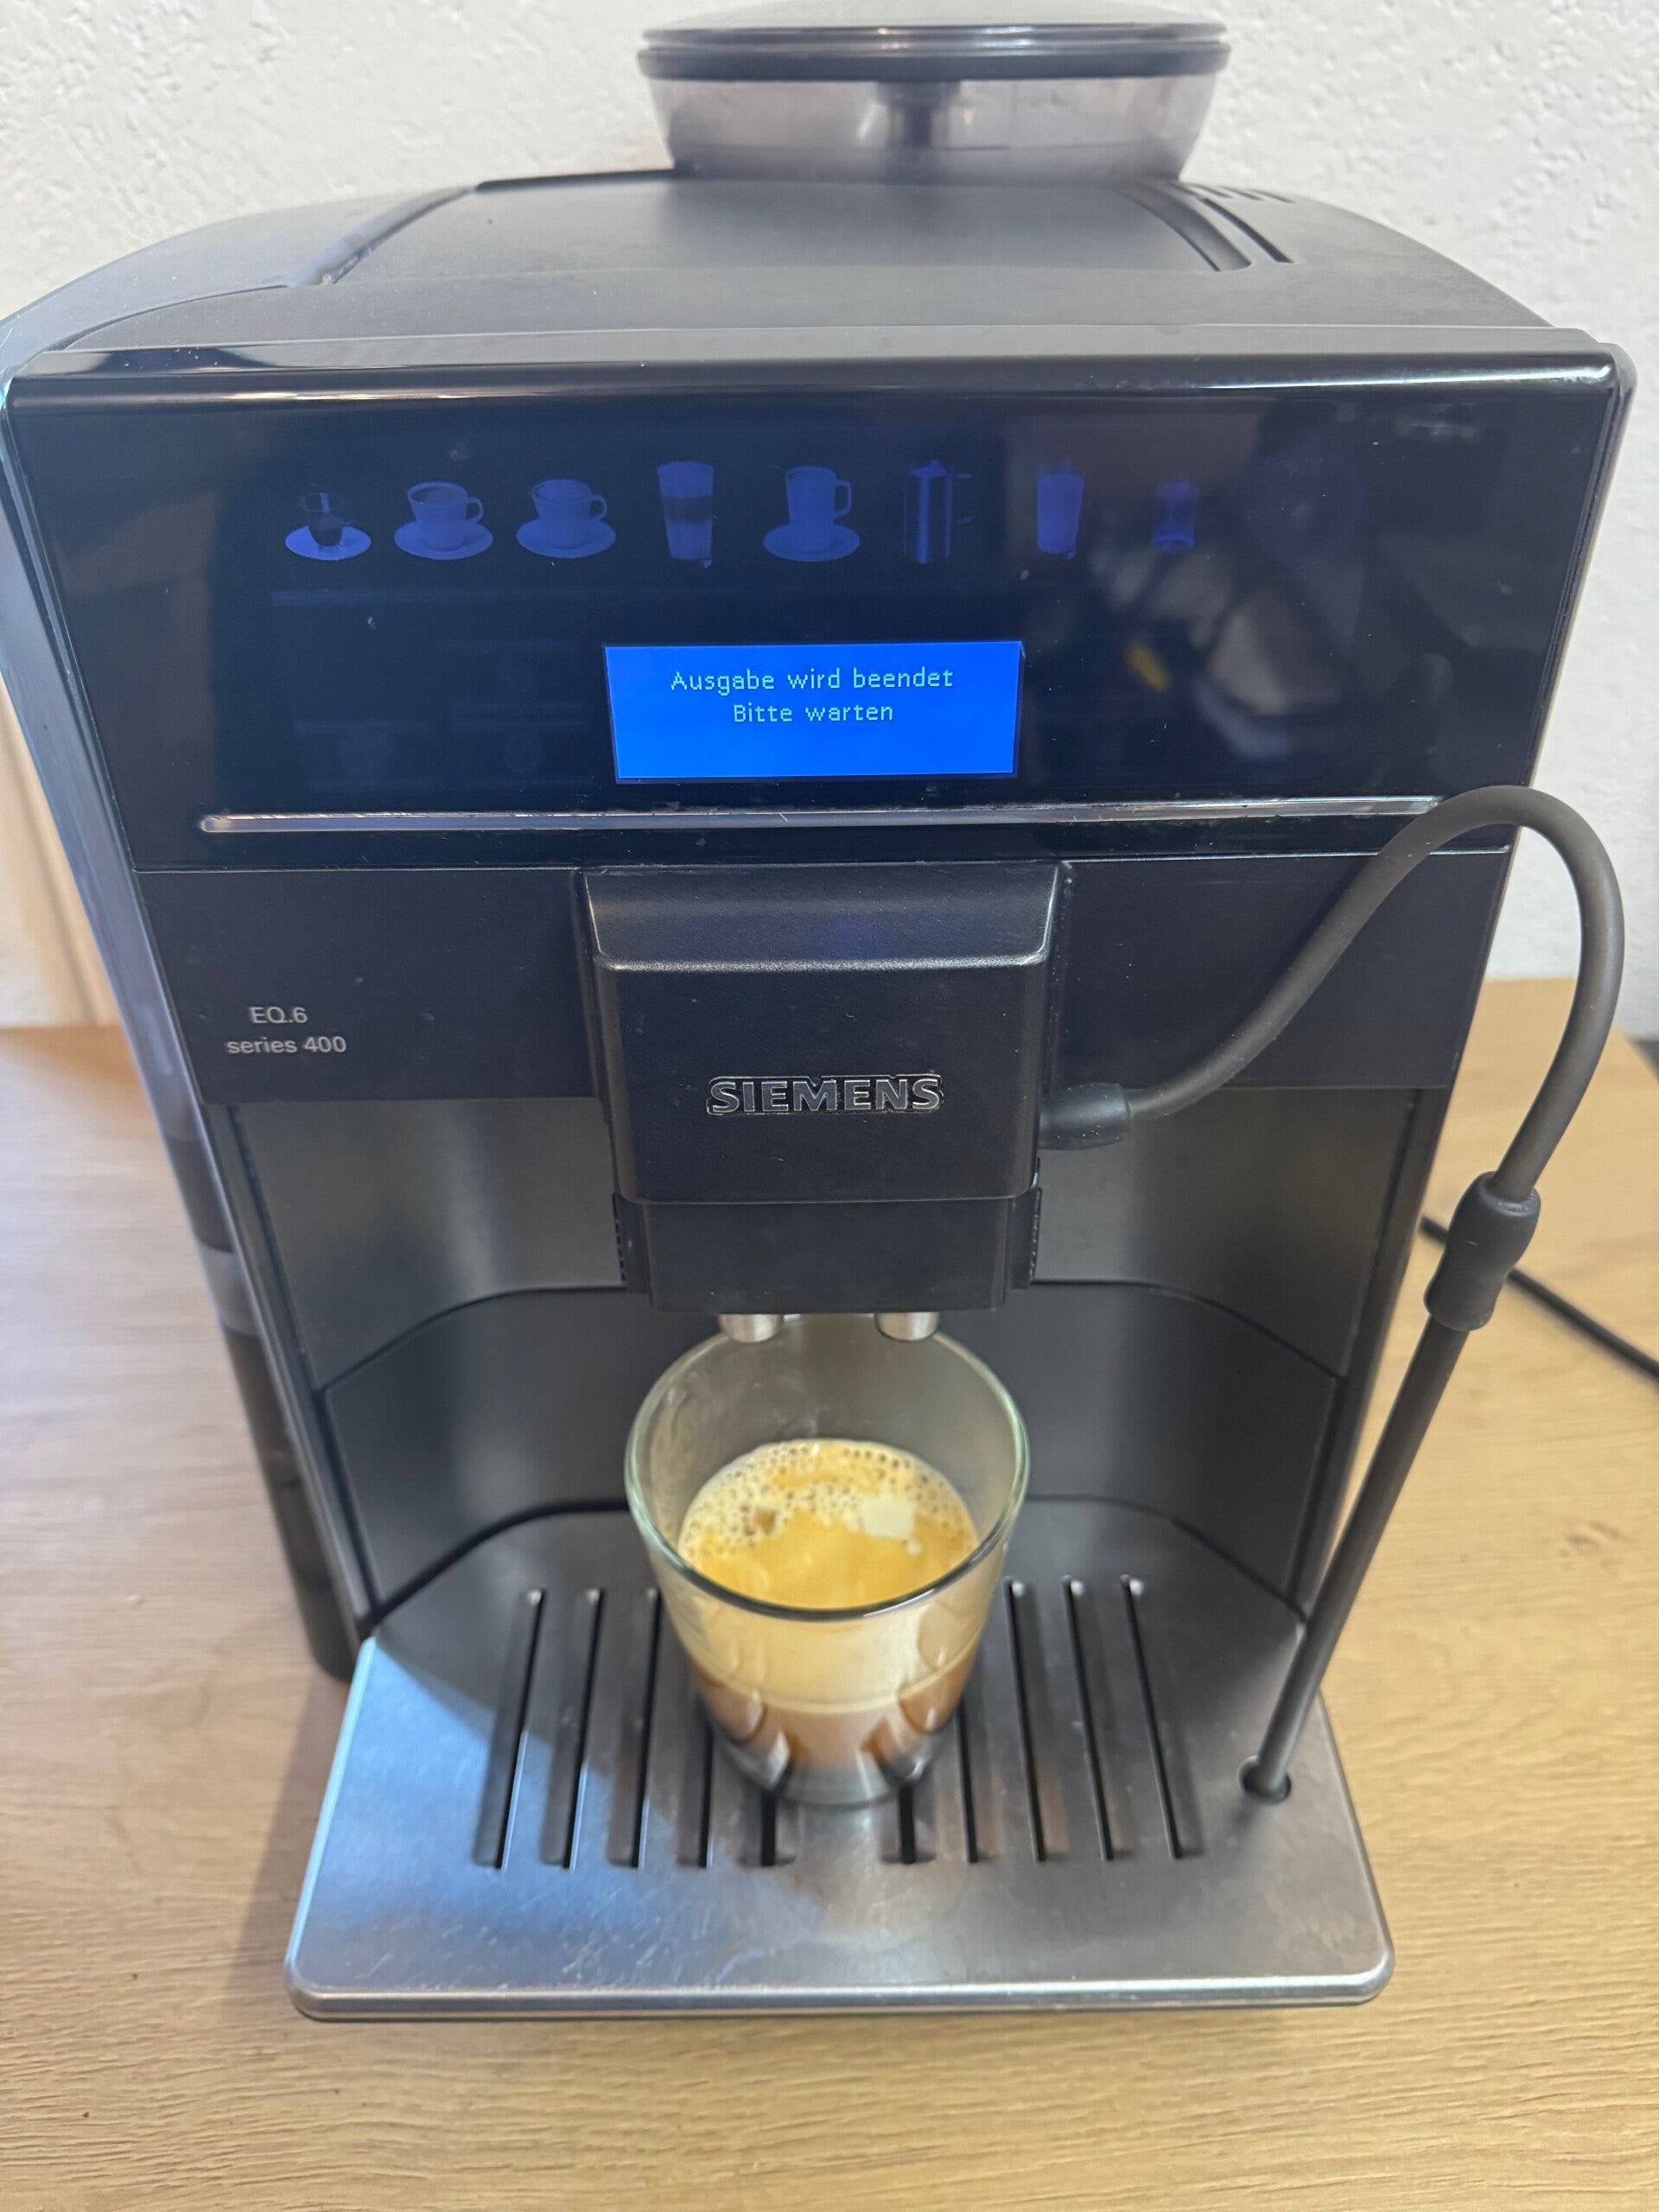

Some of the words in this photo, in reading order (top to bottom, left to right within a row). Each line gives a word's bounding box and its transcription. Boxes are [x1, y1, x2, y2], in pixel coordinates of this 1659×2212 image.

[671, 669, 775, 696] Ausgabe
[787, 667, 841, 690] wird
[853, 666, 954, 689] beendet
[733, 703, 793, 723] Bitte
[805, 704, 893, 722] warten
[249, 1006, 308, 1024] EQ.6
[225, 1036, 298, 1054] series
[303, 1035, 347, 1053] 400
[709, 1077, 943, 1113] SIEMENS
